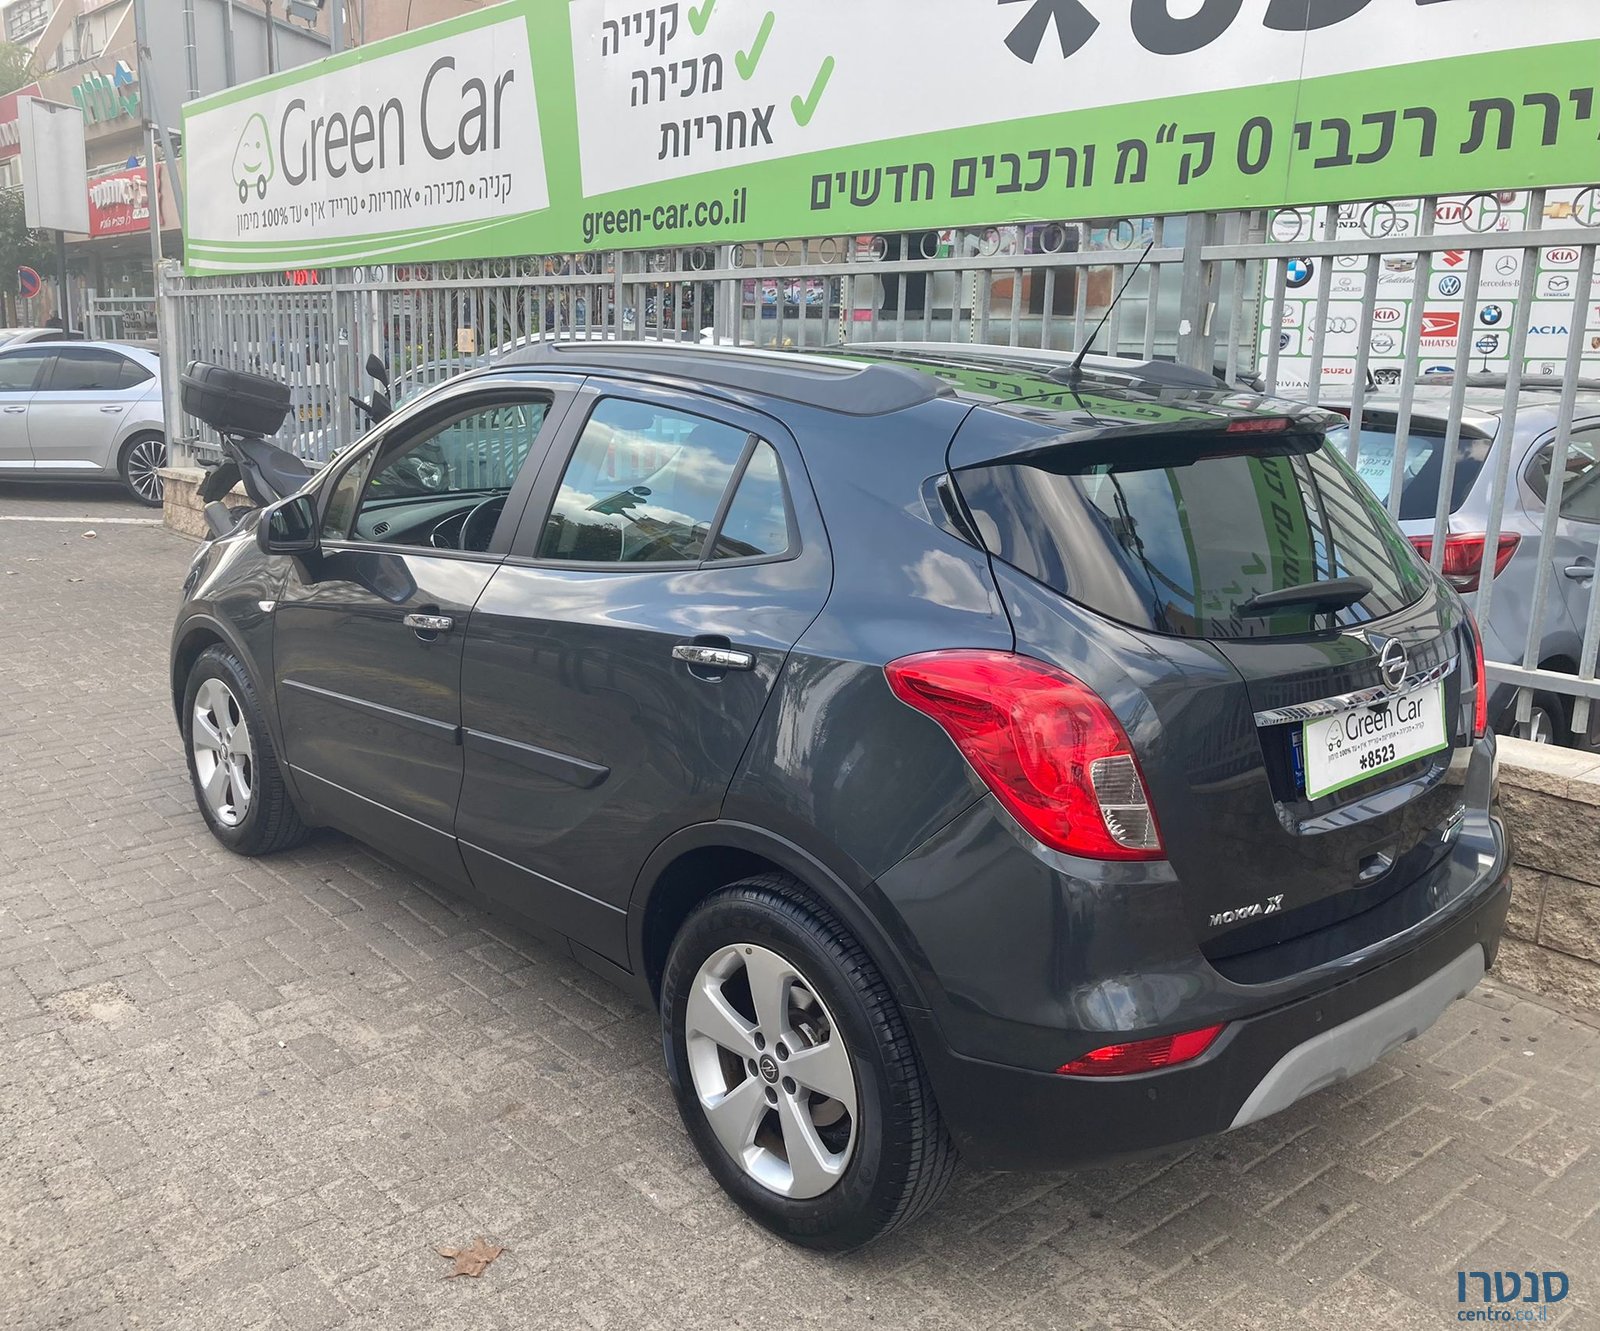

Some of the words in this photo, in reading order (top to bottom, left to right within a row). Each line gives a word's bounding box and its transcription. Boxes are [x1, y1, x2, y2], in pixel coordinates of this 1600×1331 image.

[601, 3, 679, 56] קנייה
[631, 53, 723, 107] מכירה
[280, 97, 405, 186] Green
[420, 56, 515, 160] Car
[658, 104, 776, 160] אחריות
[1293, 106, 1438, 169] רכבי
[1460, 87, 1600, 154] ירת
[1237, 116, 1273, 175] 0
[479, 173, 512, 204] קניה
[810, 162, 936, 211] חדשים
[950, 144, 1096, 199] ורכבים
[328, 196, 358, 218] טרייד
[369, 188, 412, 213] אחריות
[424, 180, 465, 206] מכירה
[237, 212, 259, 236] מימון
[262, 206, 288, 228] 100%
[290, 205, 302, 223] עד
[311, 201, 325, 226] אין
[582, 187, 747, 244] green-car.co.il
[1420, 339, 1457, 348] AIHATSU
[1528, 326, 1568, 334] ACIA
[1345, 707, 1393, 740] Green
[1396, 697, 1423, 723] Car
[1208, 903, 1263, 926] MOKKA
